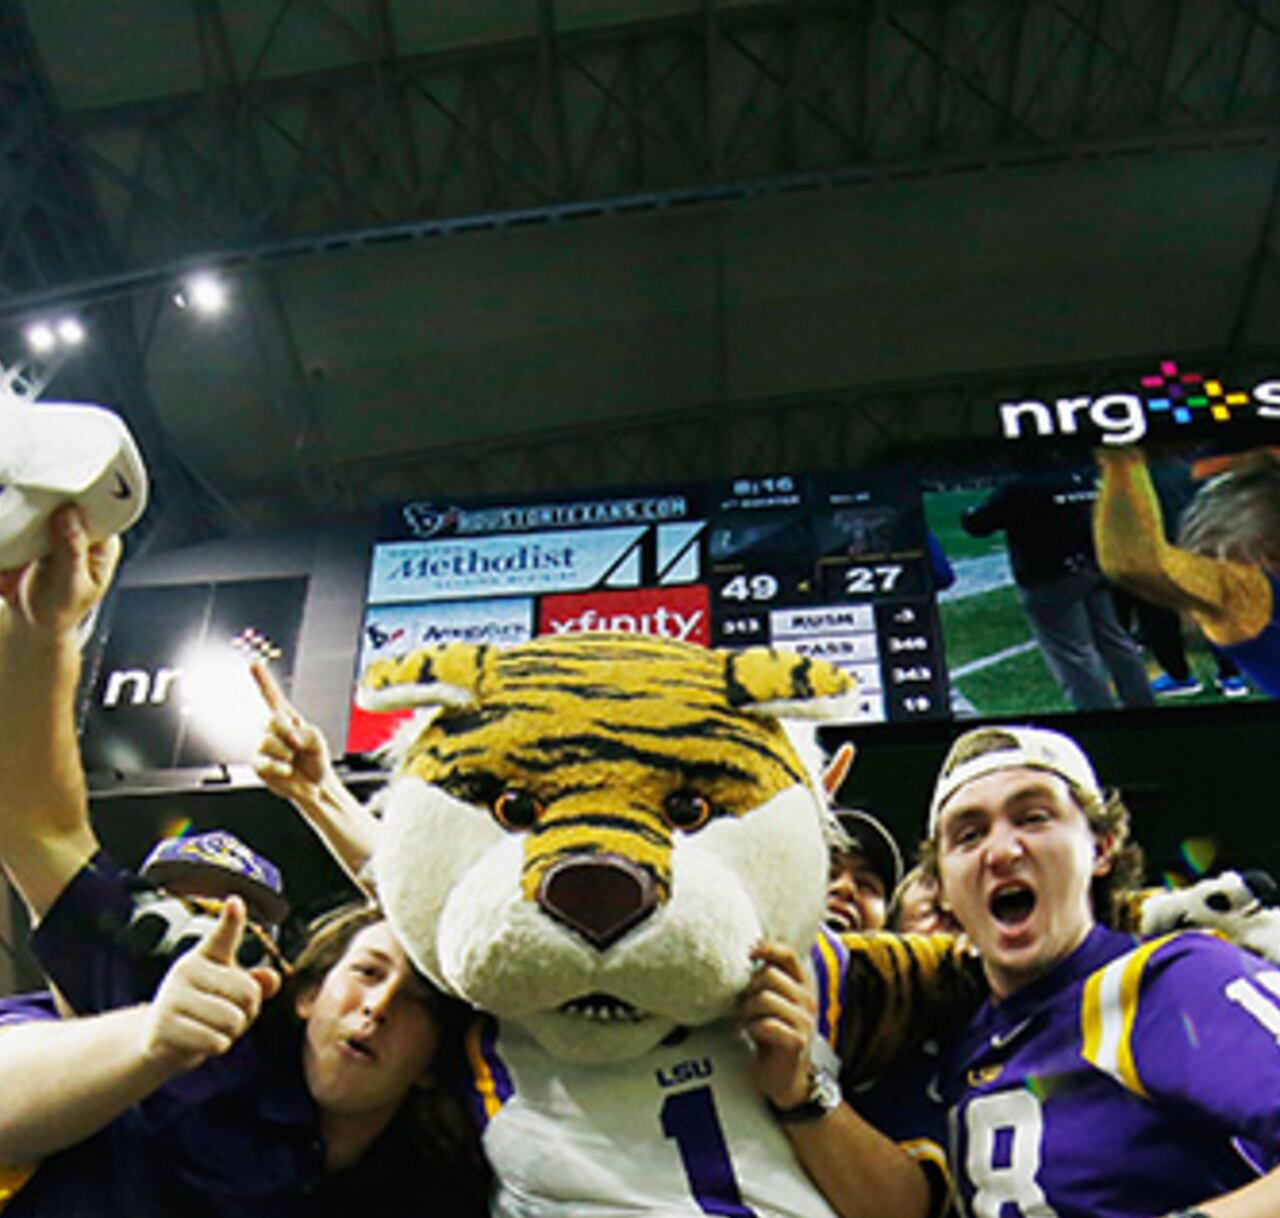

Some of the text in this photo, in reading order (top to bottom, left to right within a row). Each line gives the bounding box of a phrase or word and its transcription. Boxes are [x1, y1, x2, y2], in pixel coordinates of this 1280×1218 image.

[1000, 389, 1147, 444] nrg
[388, 545, 575, 581] Methodist
[845, 565, 903, 594] 27
[721, 574, 779, 602] 49
[549, 606, 705, 640] xfinity
[103, 667, 186, 707] nr
[655, 1057, 715, 1088] LSU
